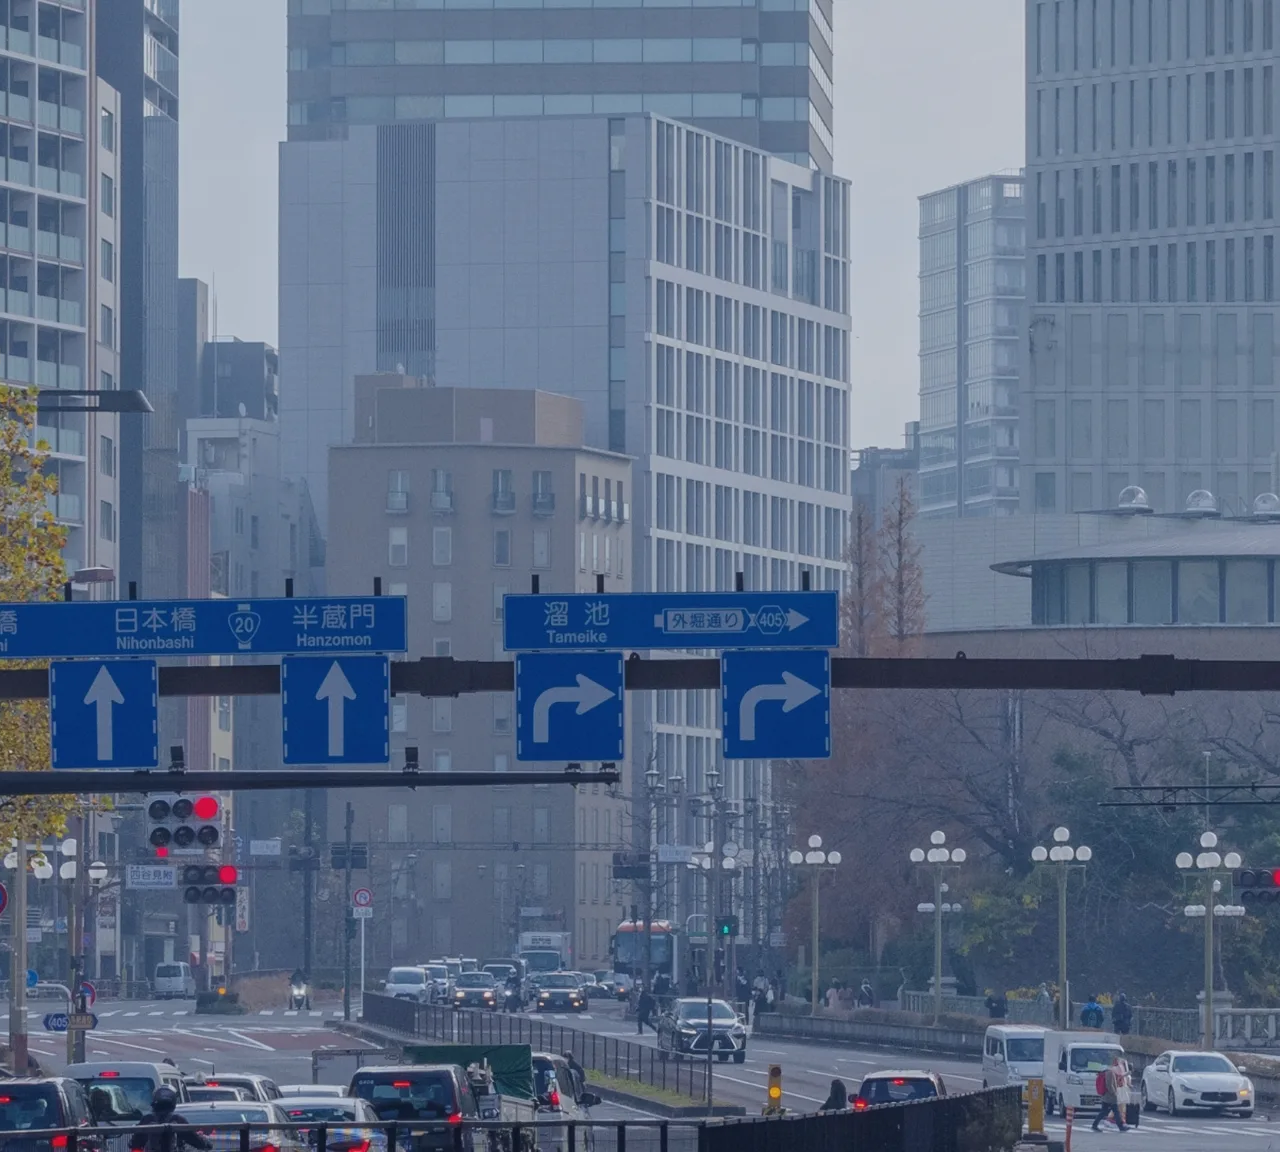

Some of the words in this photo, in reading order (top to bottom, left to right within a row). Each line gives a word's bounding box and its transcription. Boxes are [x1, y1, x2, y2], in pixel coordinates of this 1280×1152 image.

[115, 606, 196, 633] 日本橋
[292, 604, 375, 630] 半蔵門
[543, 601, 610, 627] 溜池
[671, 612, 740, 629] 外堀通り
[758, 612, 783, 628] 405
[234, 617, 254, 634] 20
[116, 635, 194, 650] Nihonbashi
[297, 633, 372, 647] Hanzomon
[546, 630, 608, 643] Tameike
[51, 1017, 68, 1028] 405
